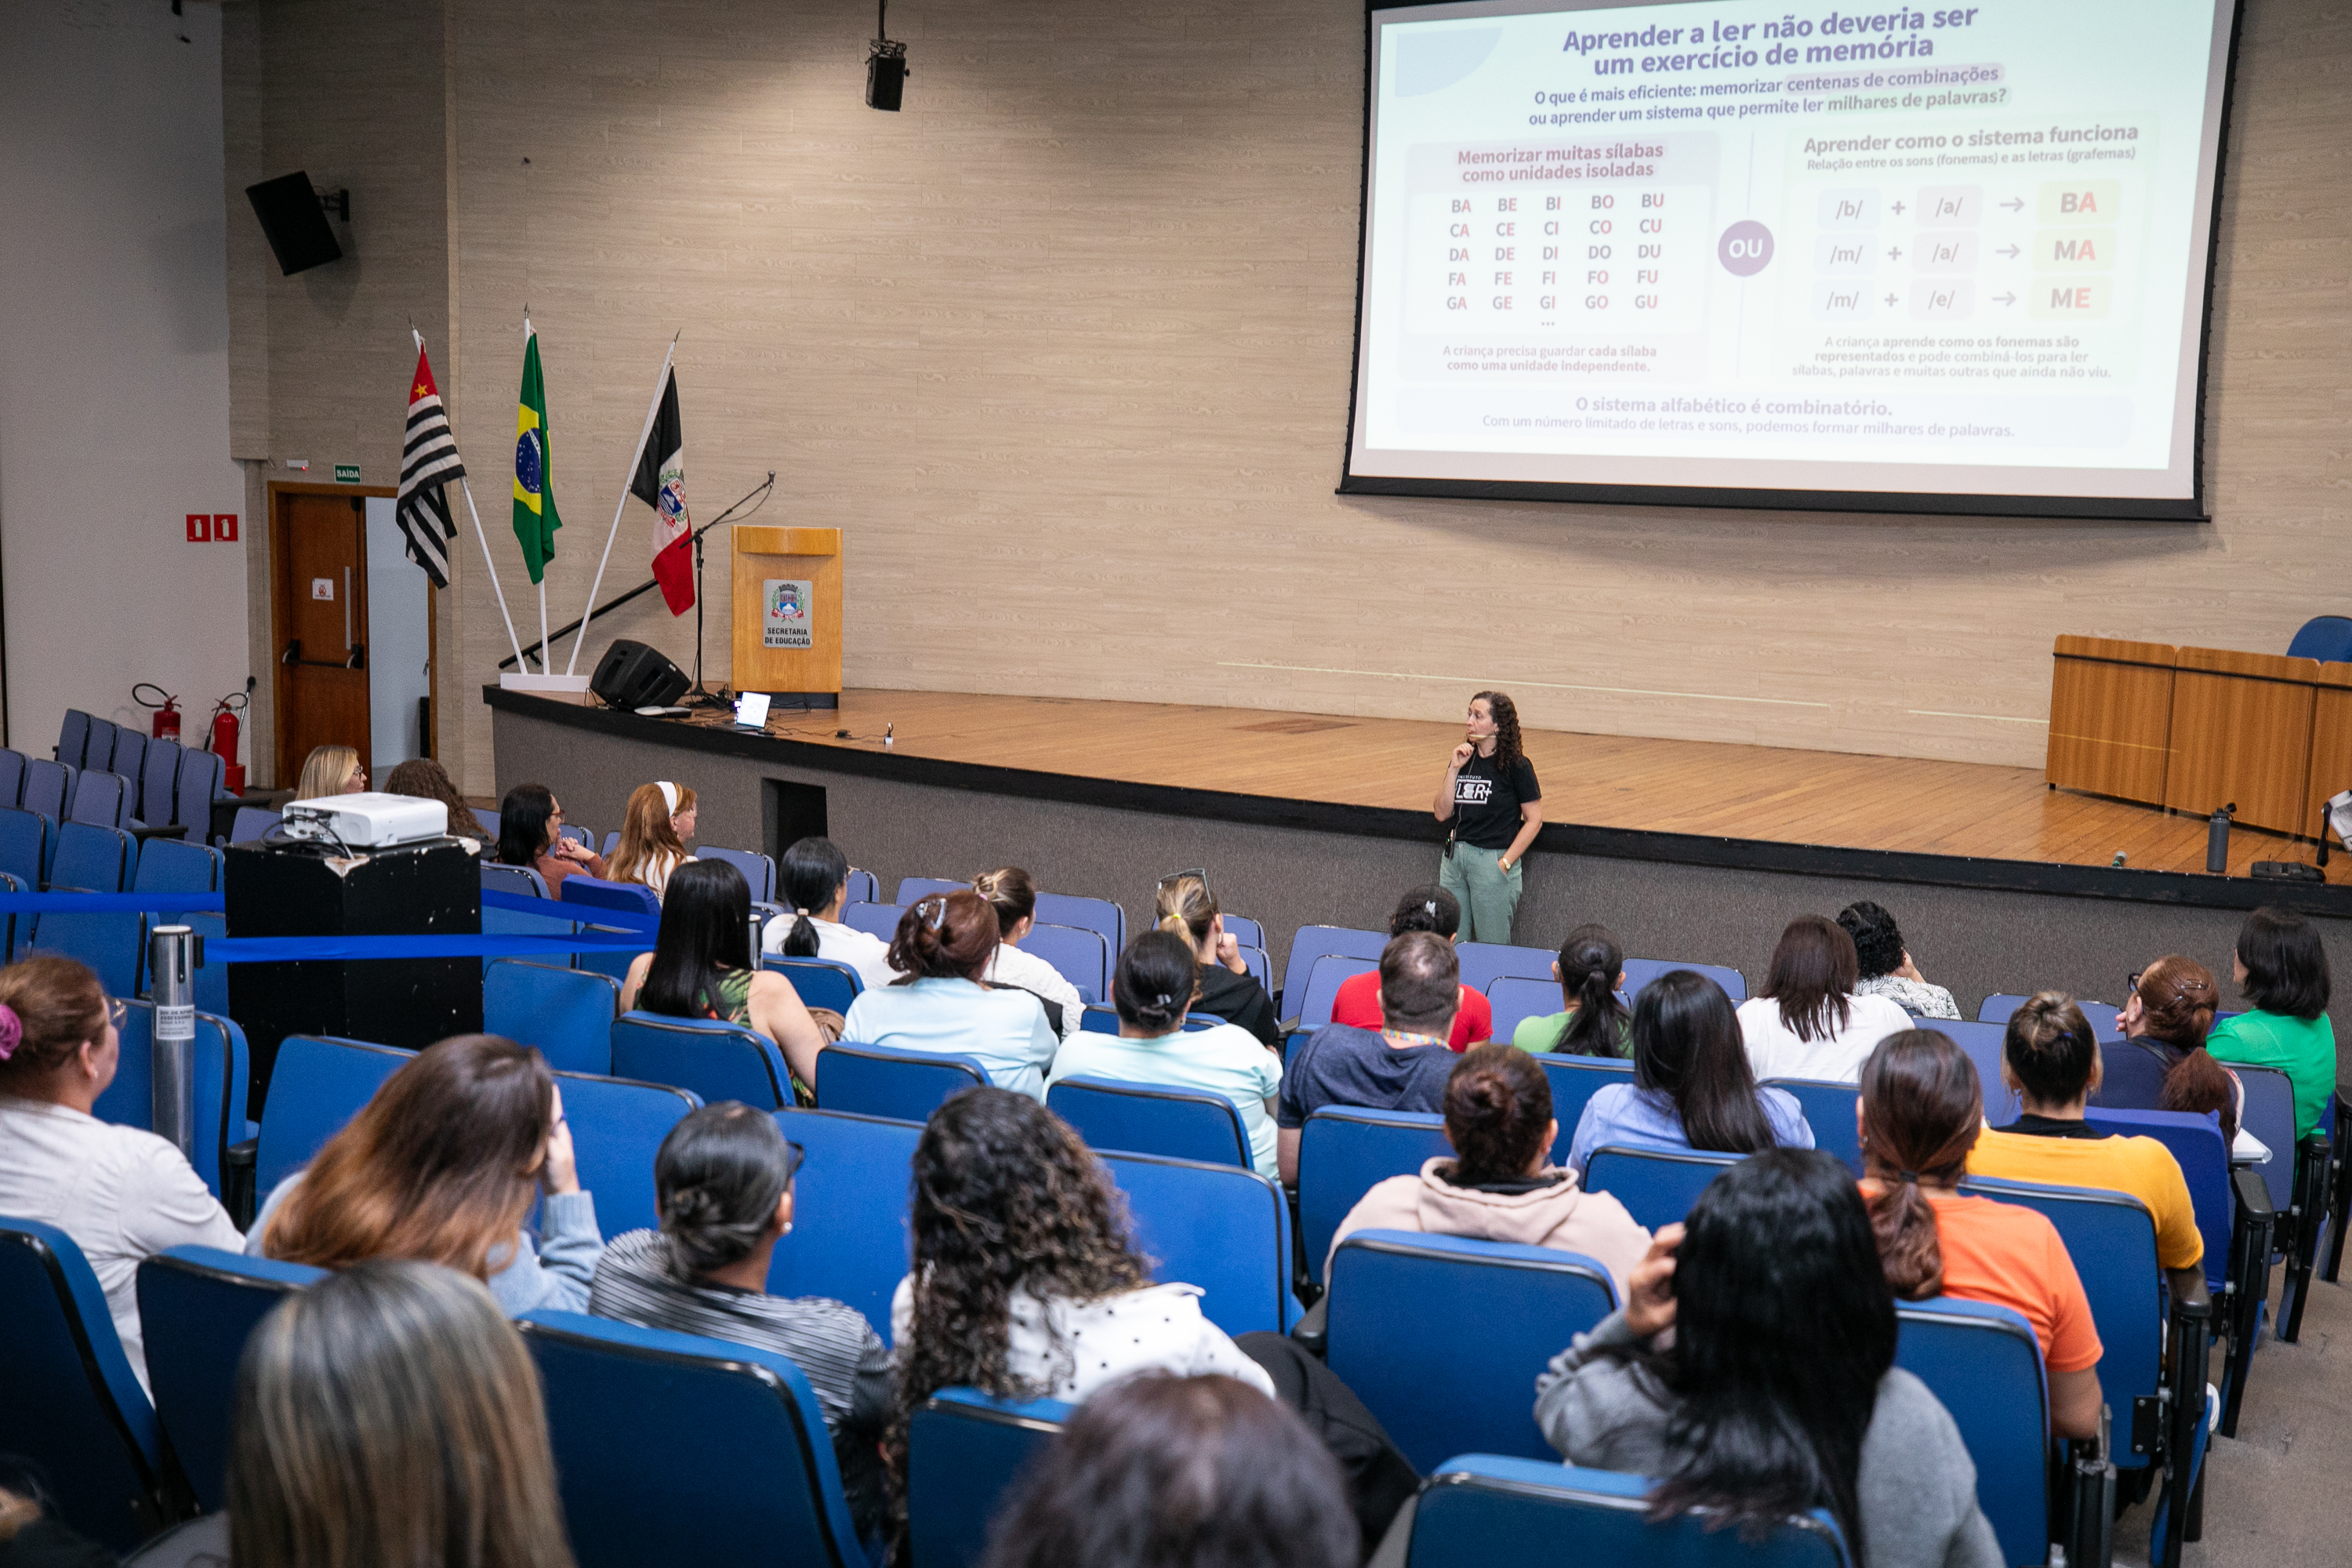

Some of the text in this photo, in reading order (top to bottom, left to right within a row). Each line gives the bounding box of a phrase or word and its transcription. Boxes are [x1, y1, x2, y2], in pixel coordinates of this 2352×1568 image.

[1563, 7, 1978, 56] Aprender a ler não deveria ser
[1595, 33, 1933, 75] um exercício de memória
[1534, 67, 1998, 107] O que é mais eficiente: memorizar centenas de combinações
[1529, 88, 2007, 127] ou aprender um sistema que permite ler milhares de palavras?
[1804, 125, 2138, 154] Aprender como o sistema funciona
[1458, 143, 1663, 164] Memorizar muitas sílabas
[1807, 146, 2136, 172] Relação entre os sons (fonemas) e as letras (grafemas)
[1462, 162, 1653, 182] como unidades isoladas
[1452, 194, 1664, 213] BA BE BI BO BU
[1836, 192, 2096, 220] /b/ + /a/ BA
[1450, 219, 1661, 238] CA CE CI CO CU
[1450, 245, 1661, 262] DA DE DI DO DU
[1729, 238, 1763, 259] OU
[1830, 239, 2096, 264] /m/ + /a/ MA
[1449, 270, 1658, 285] FA FE FI FO FU
[1446, 295, 1657, 310] GA GE GI GO GU
[1827, 288, 2091, 310] /m/ + /e/ ME
[1443, 345, 1657, 359] A criança precisa guardar cada sílaba
[1824, 336, 2079, 350] A criança aprende como os fonemas são
[1510, 360, 1558, 371] unidade
[1561, 360, 1650, 374] independente.
[1815, 350, 2089, 365] representados e pode combiná-los para ler
[1792, 364, 2111, 379] sílabas, palavras e muitas outras que ainda não viu.
[1576, 397, 1892, 416] O sistema alfabético é combinatório.
[1483, 415, 2014, 438] Com um número limitado de letras e sons, podemos formar milhares de palavras.
[336, 468, 360, 478] SAÍDA
[768, 627, 808, 636] SECRETARIA
[775, 637, 811, 646] EDUCAÇÃO
